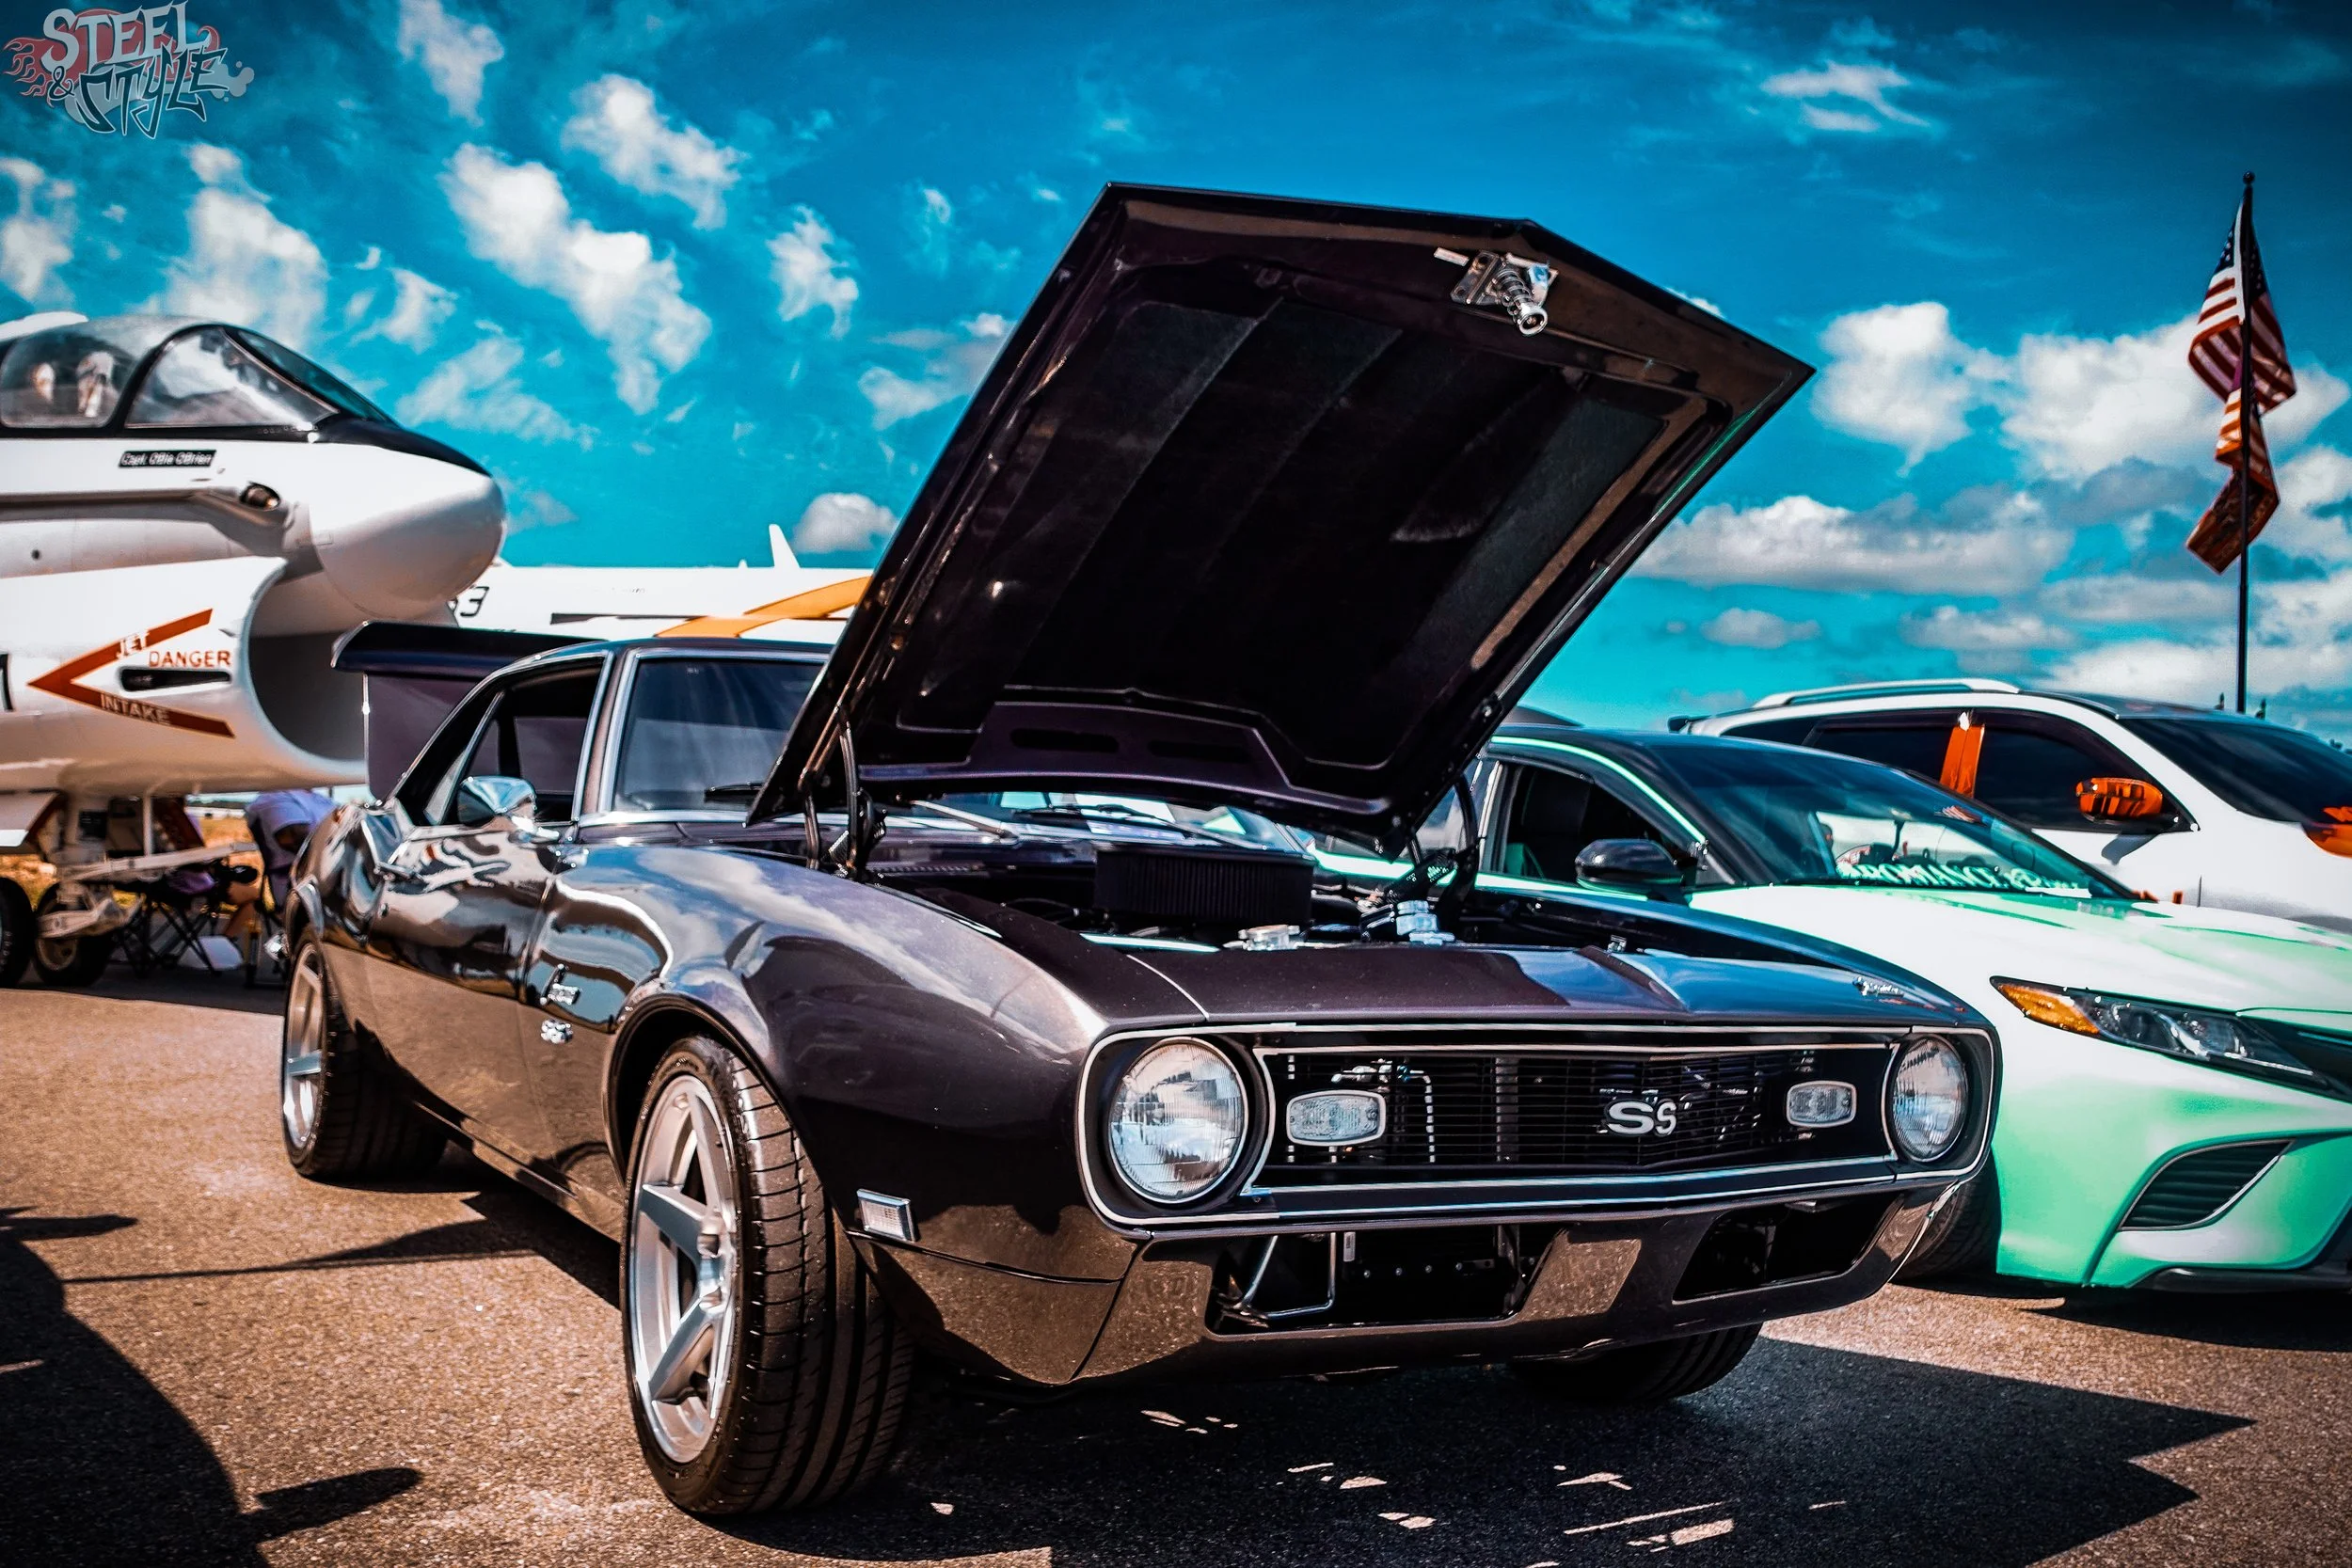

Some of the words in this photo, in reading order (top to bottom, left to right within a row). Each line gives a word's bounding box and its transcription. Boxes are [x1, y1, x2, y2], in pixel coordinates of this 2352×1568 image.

[116, 631, 150, 658] JET
[149, 650, 231, 668] DANGER
[101, 693, 171, 725] INTAKE
[1607, 1101, 1677, 1135] SS
